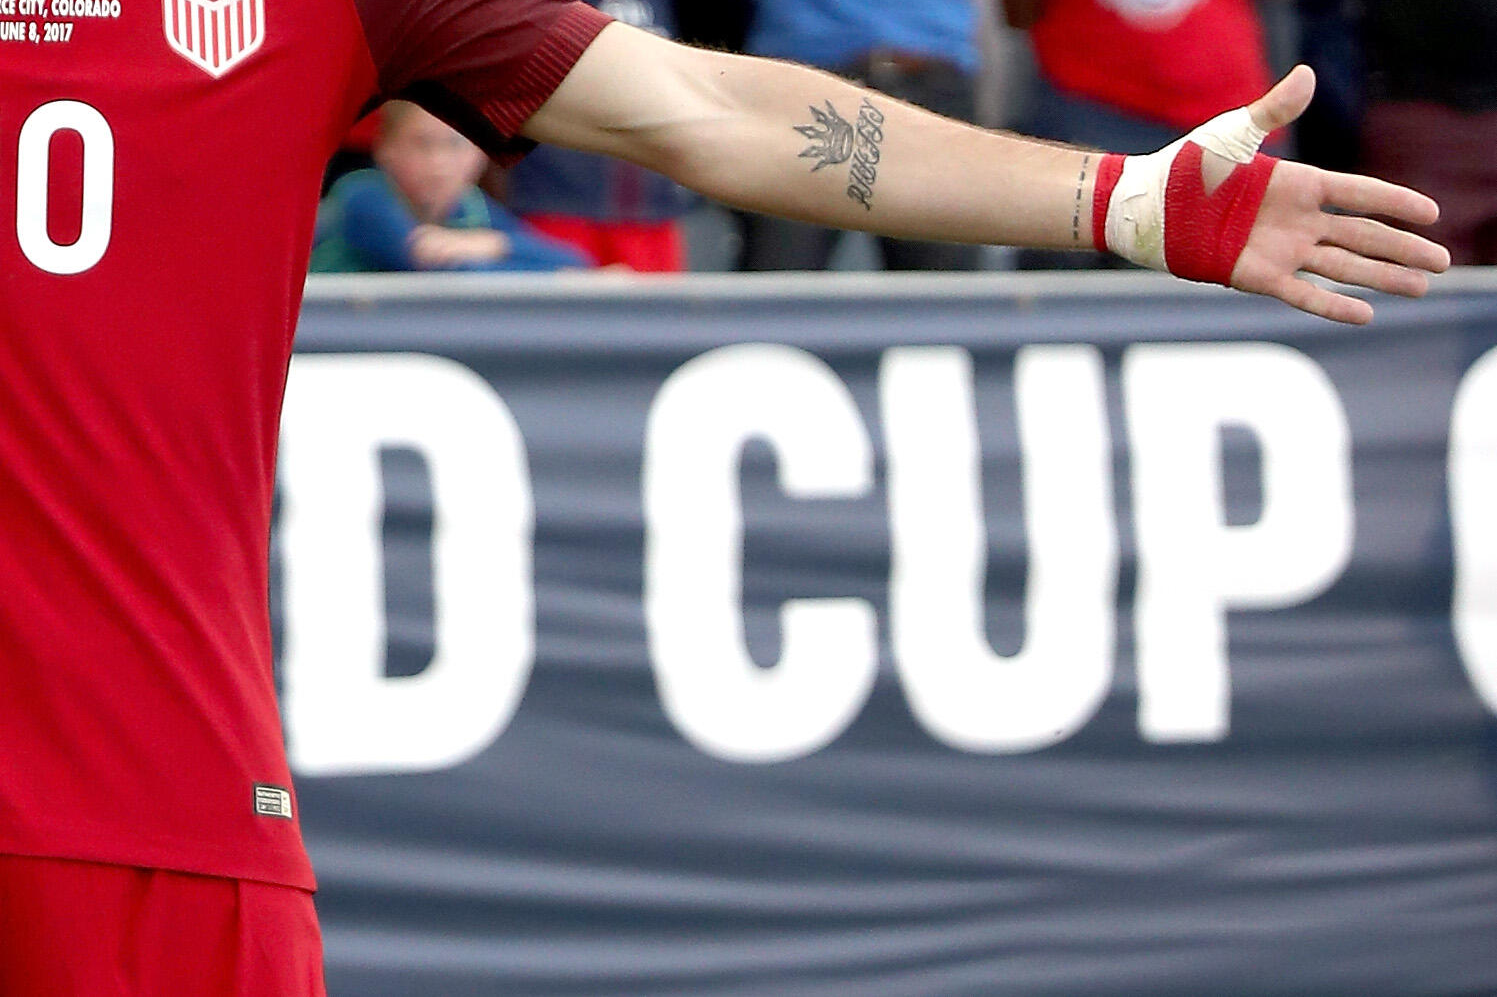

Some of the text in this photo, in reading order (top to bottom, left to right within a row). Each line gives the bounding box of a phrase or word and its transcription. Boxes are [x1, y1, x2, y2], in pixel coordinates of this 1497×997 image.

[28, 22, 40, 44] 8,
[43, 22, 74, 42] 2017
[644, 341, 1354, 764] CUP
